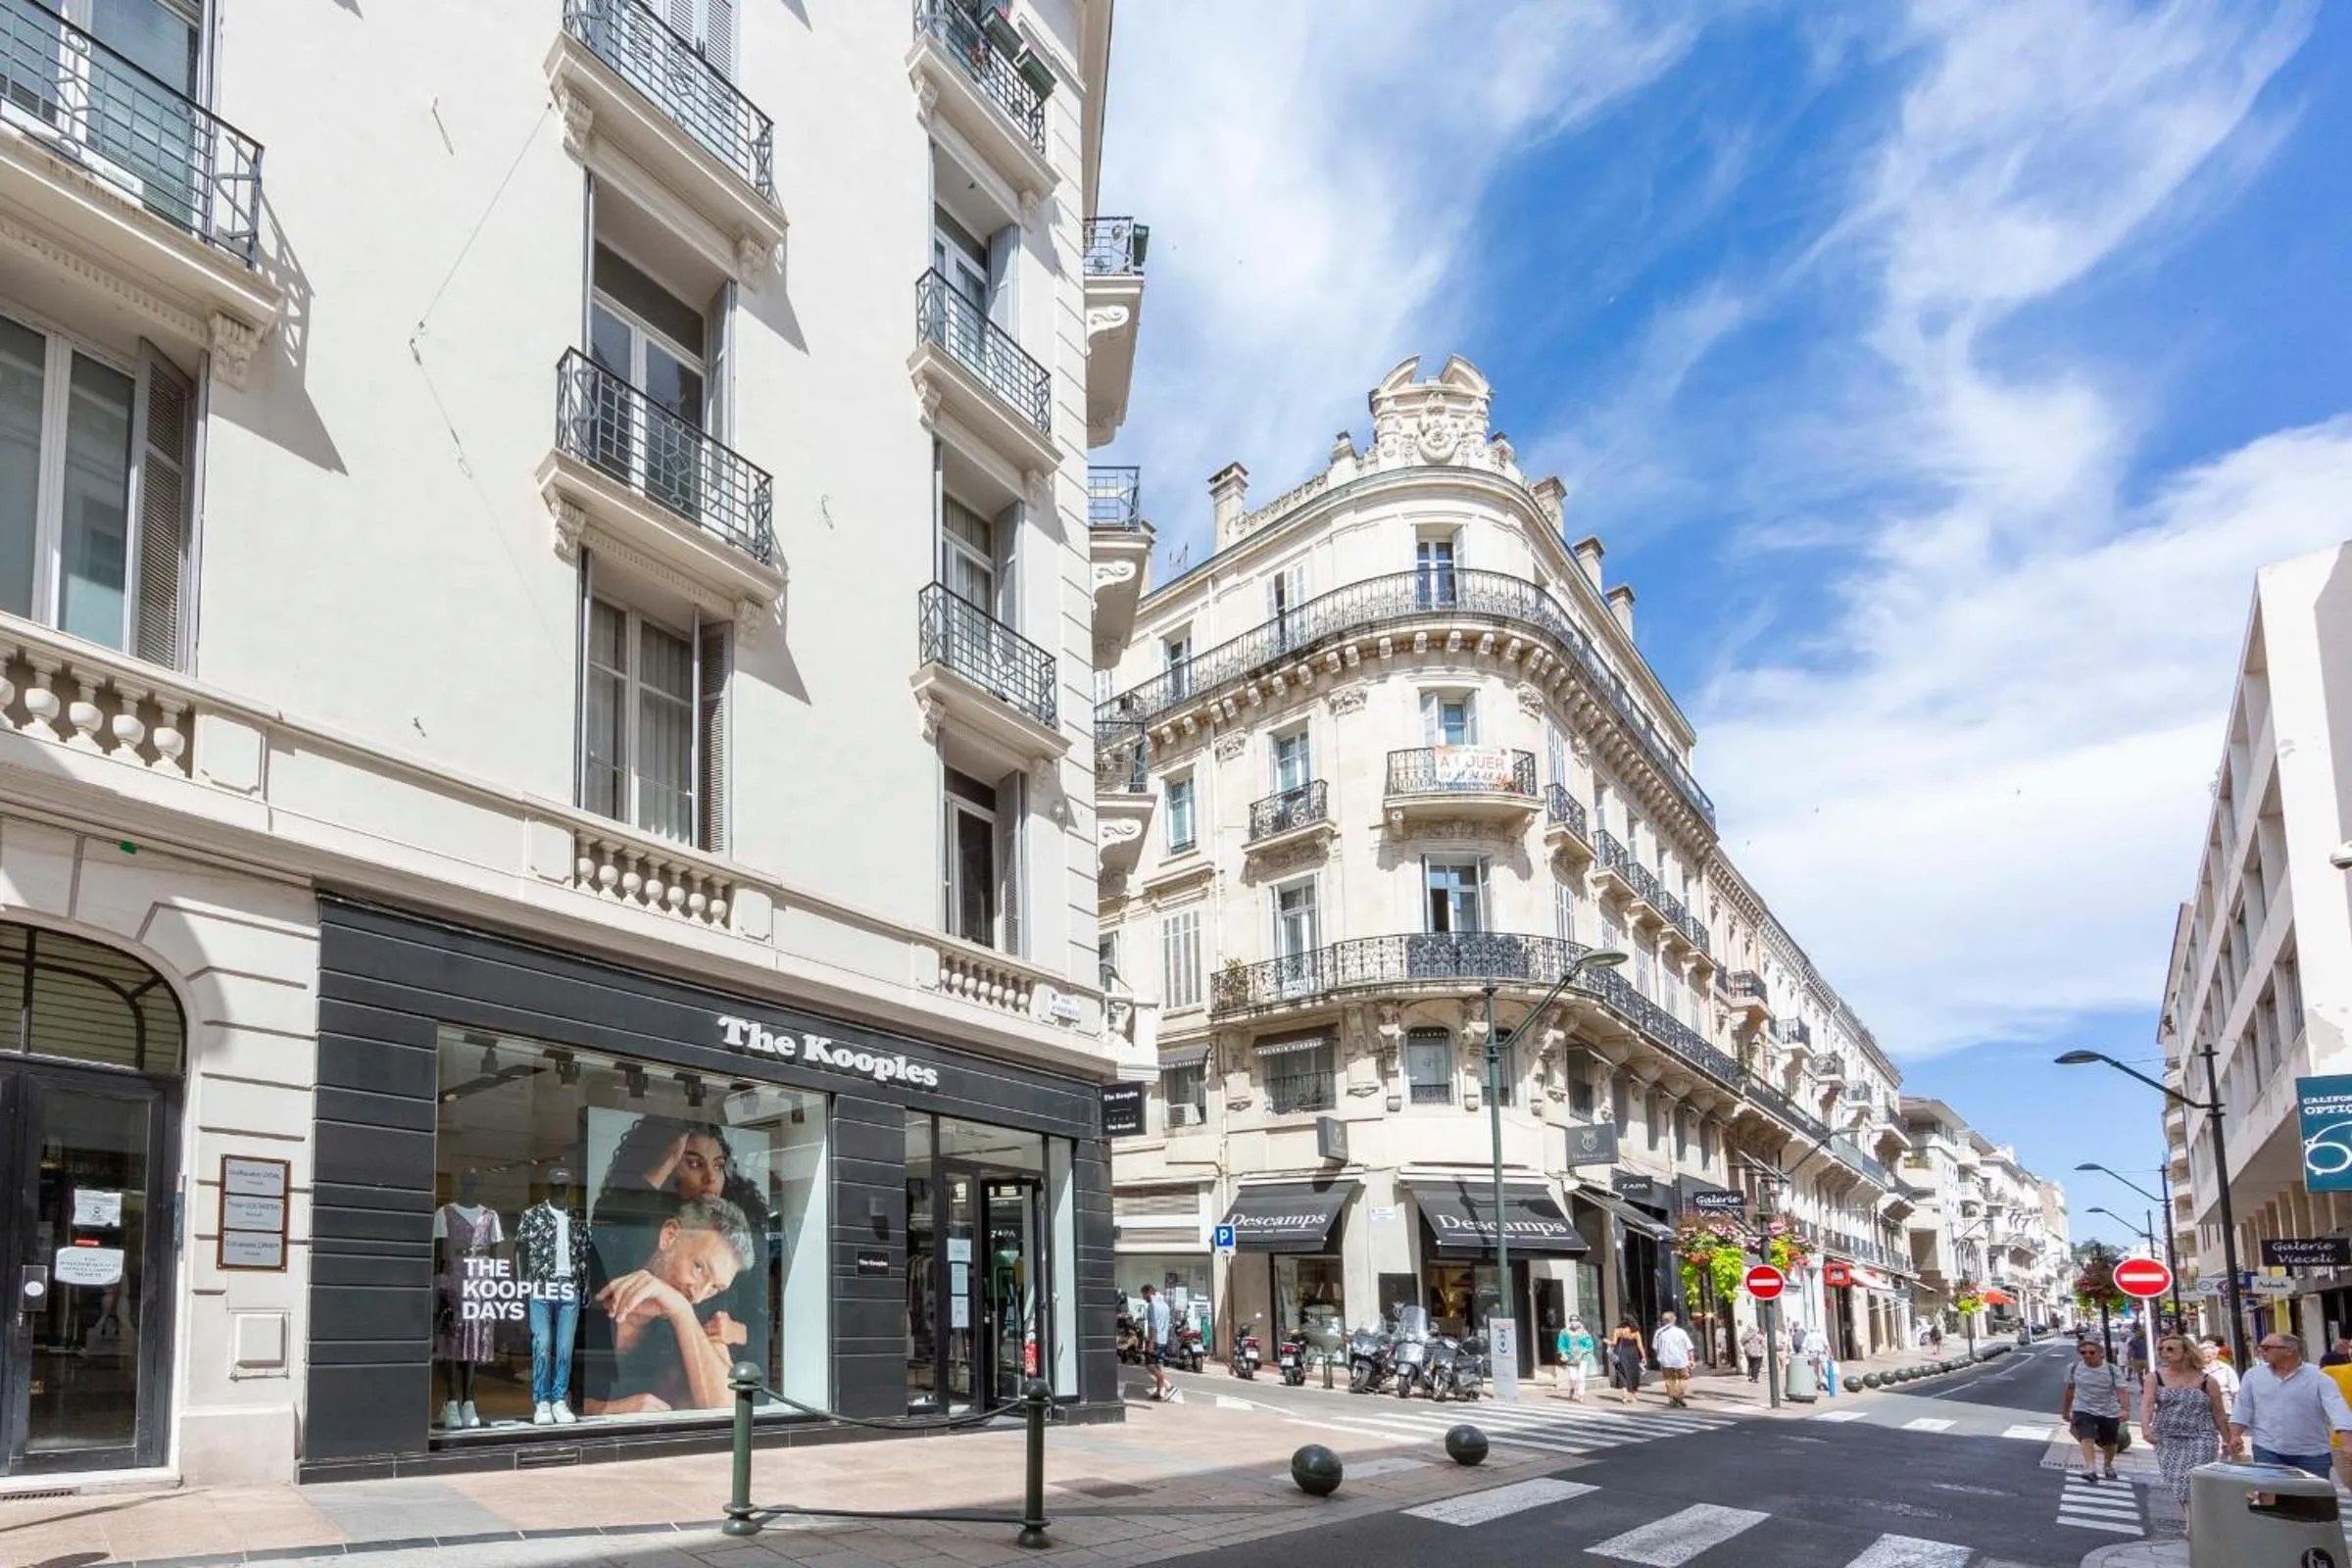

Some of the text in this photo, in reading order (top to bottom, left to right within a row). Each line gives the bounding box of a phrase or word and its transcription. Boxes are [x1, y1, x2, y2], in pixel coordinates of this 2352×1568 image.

[716, 1015, 939, 1087] The Kooples
[1695, 1195, 1740, 1204] Galerie
[1229, 1213, 1327, 1229] Descamps
[1435, 1214, 1567, 1236] Descamps
[1219, 1230, 1229, 1245] P
[2272, 1242, 2334, 1251] Galerie
[464, 1258, 510, 1277] THE
[462, 1279, 575, 1300] KOOPLES
[462, 1300, 525, 1320] DAYS
